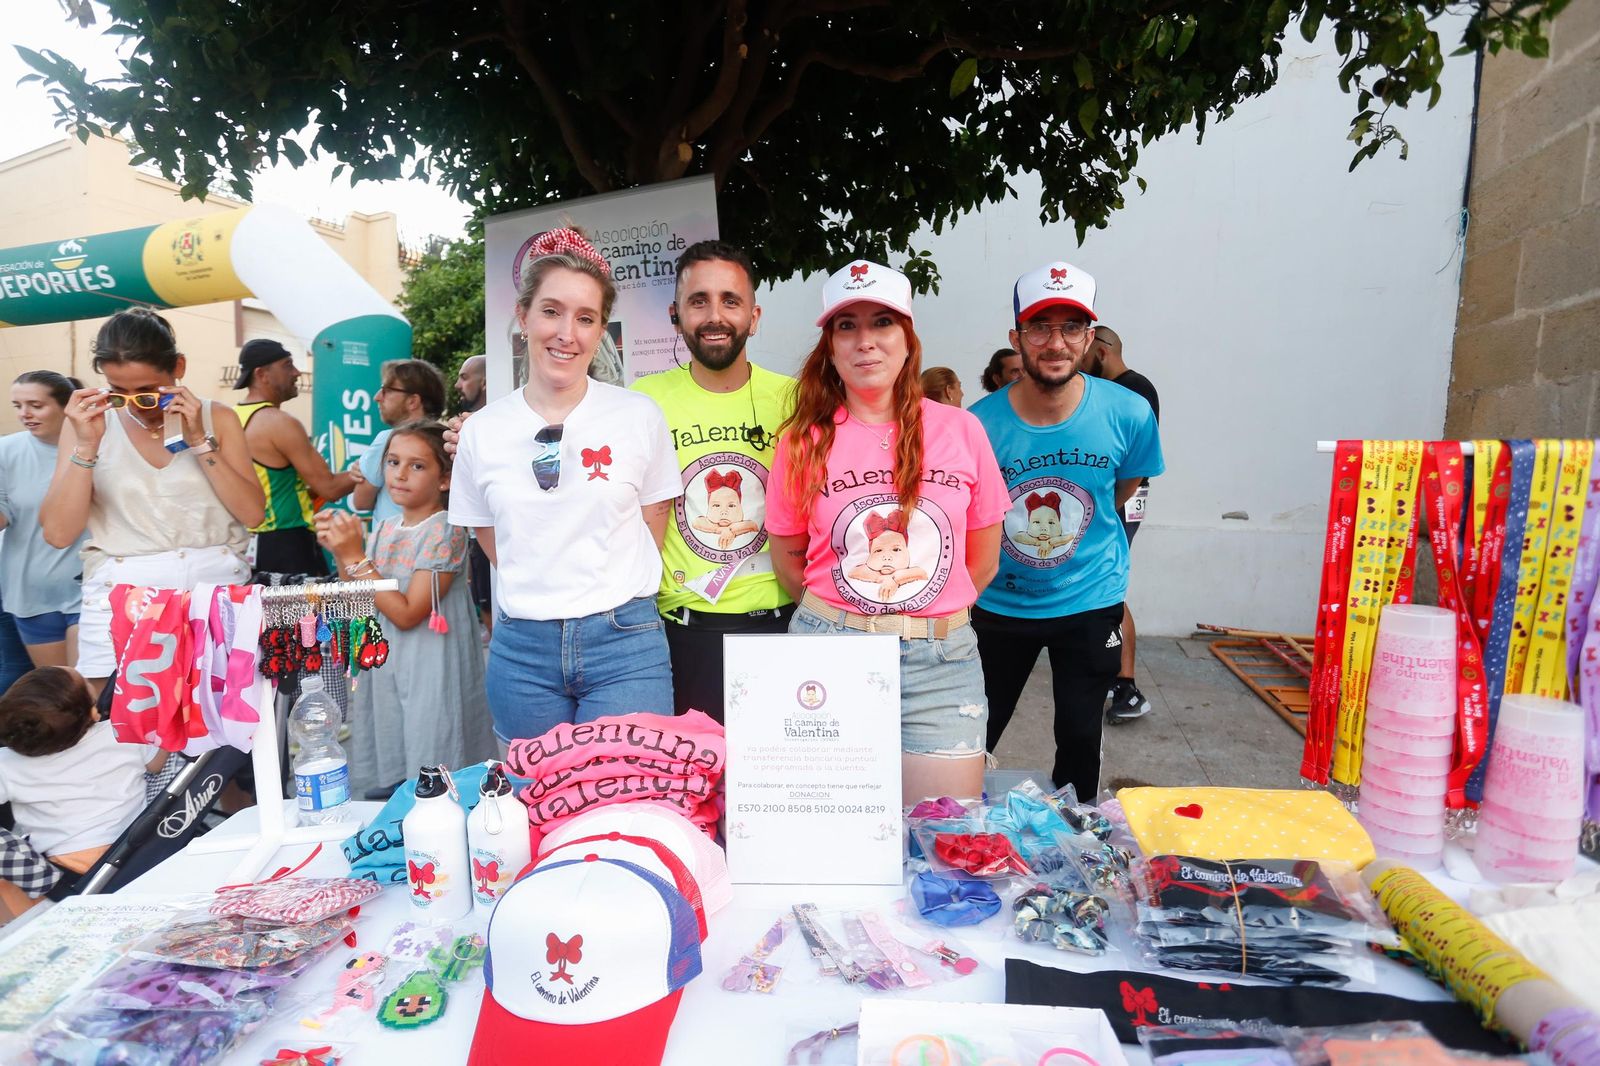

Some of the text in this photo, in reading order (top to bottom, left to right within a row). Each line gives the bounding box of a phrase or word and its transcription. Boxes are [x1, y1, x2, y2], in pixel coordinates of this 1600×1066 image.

[594, 219, 669, 245] Asociación
[667, 233, 687, 251] de
[719, 552, 733, 562] de
[784, 718, 840, 727] El camino de
[784, 726, 840, 738] Valentina
[505, 723, 719, 777] Valentina
[737, 781, 752, 789] Para
[753, 782, 785, 791] colaborar,
[795, 783, 827, 791] concepto
[737, 804, 886, 814] ES70 2100 8508 5102 0024 8219
[531, 971, 600, 1005] El camino de Valentina
